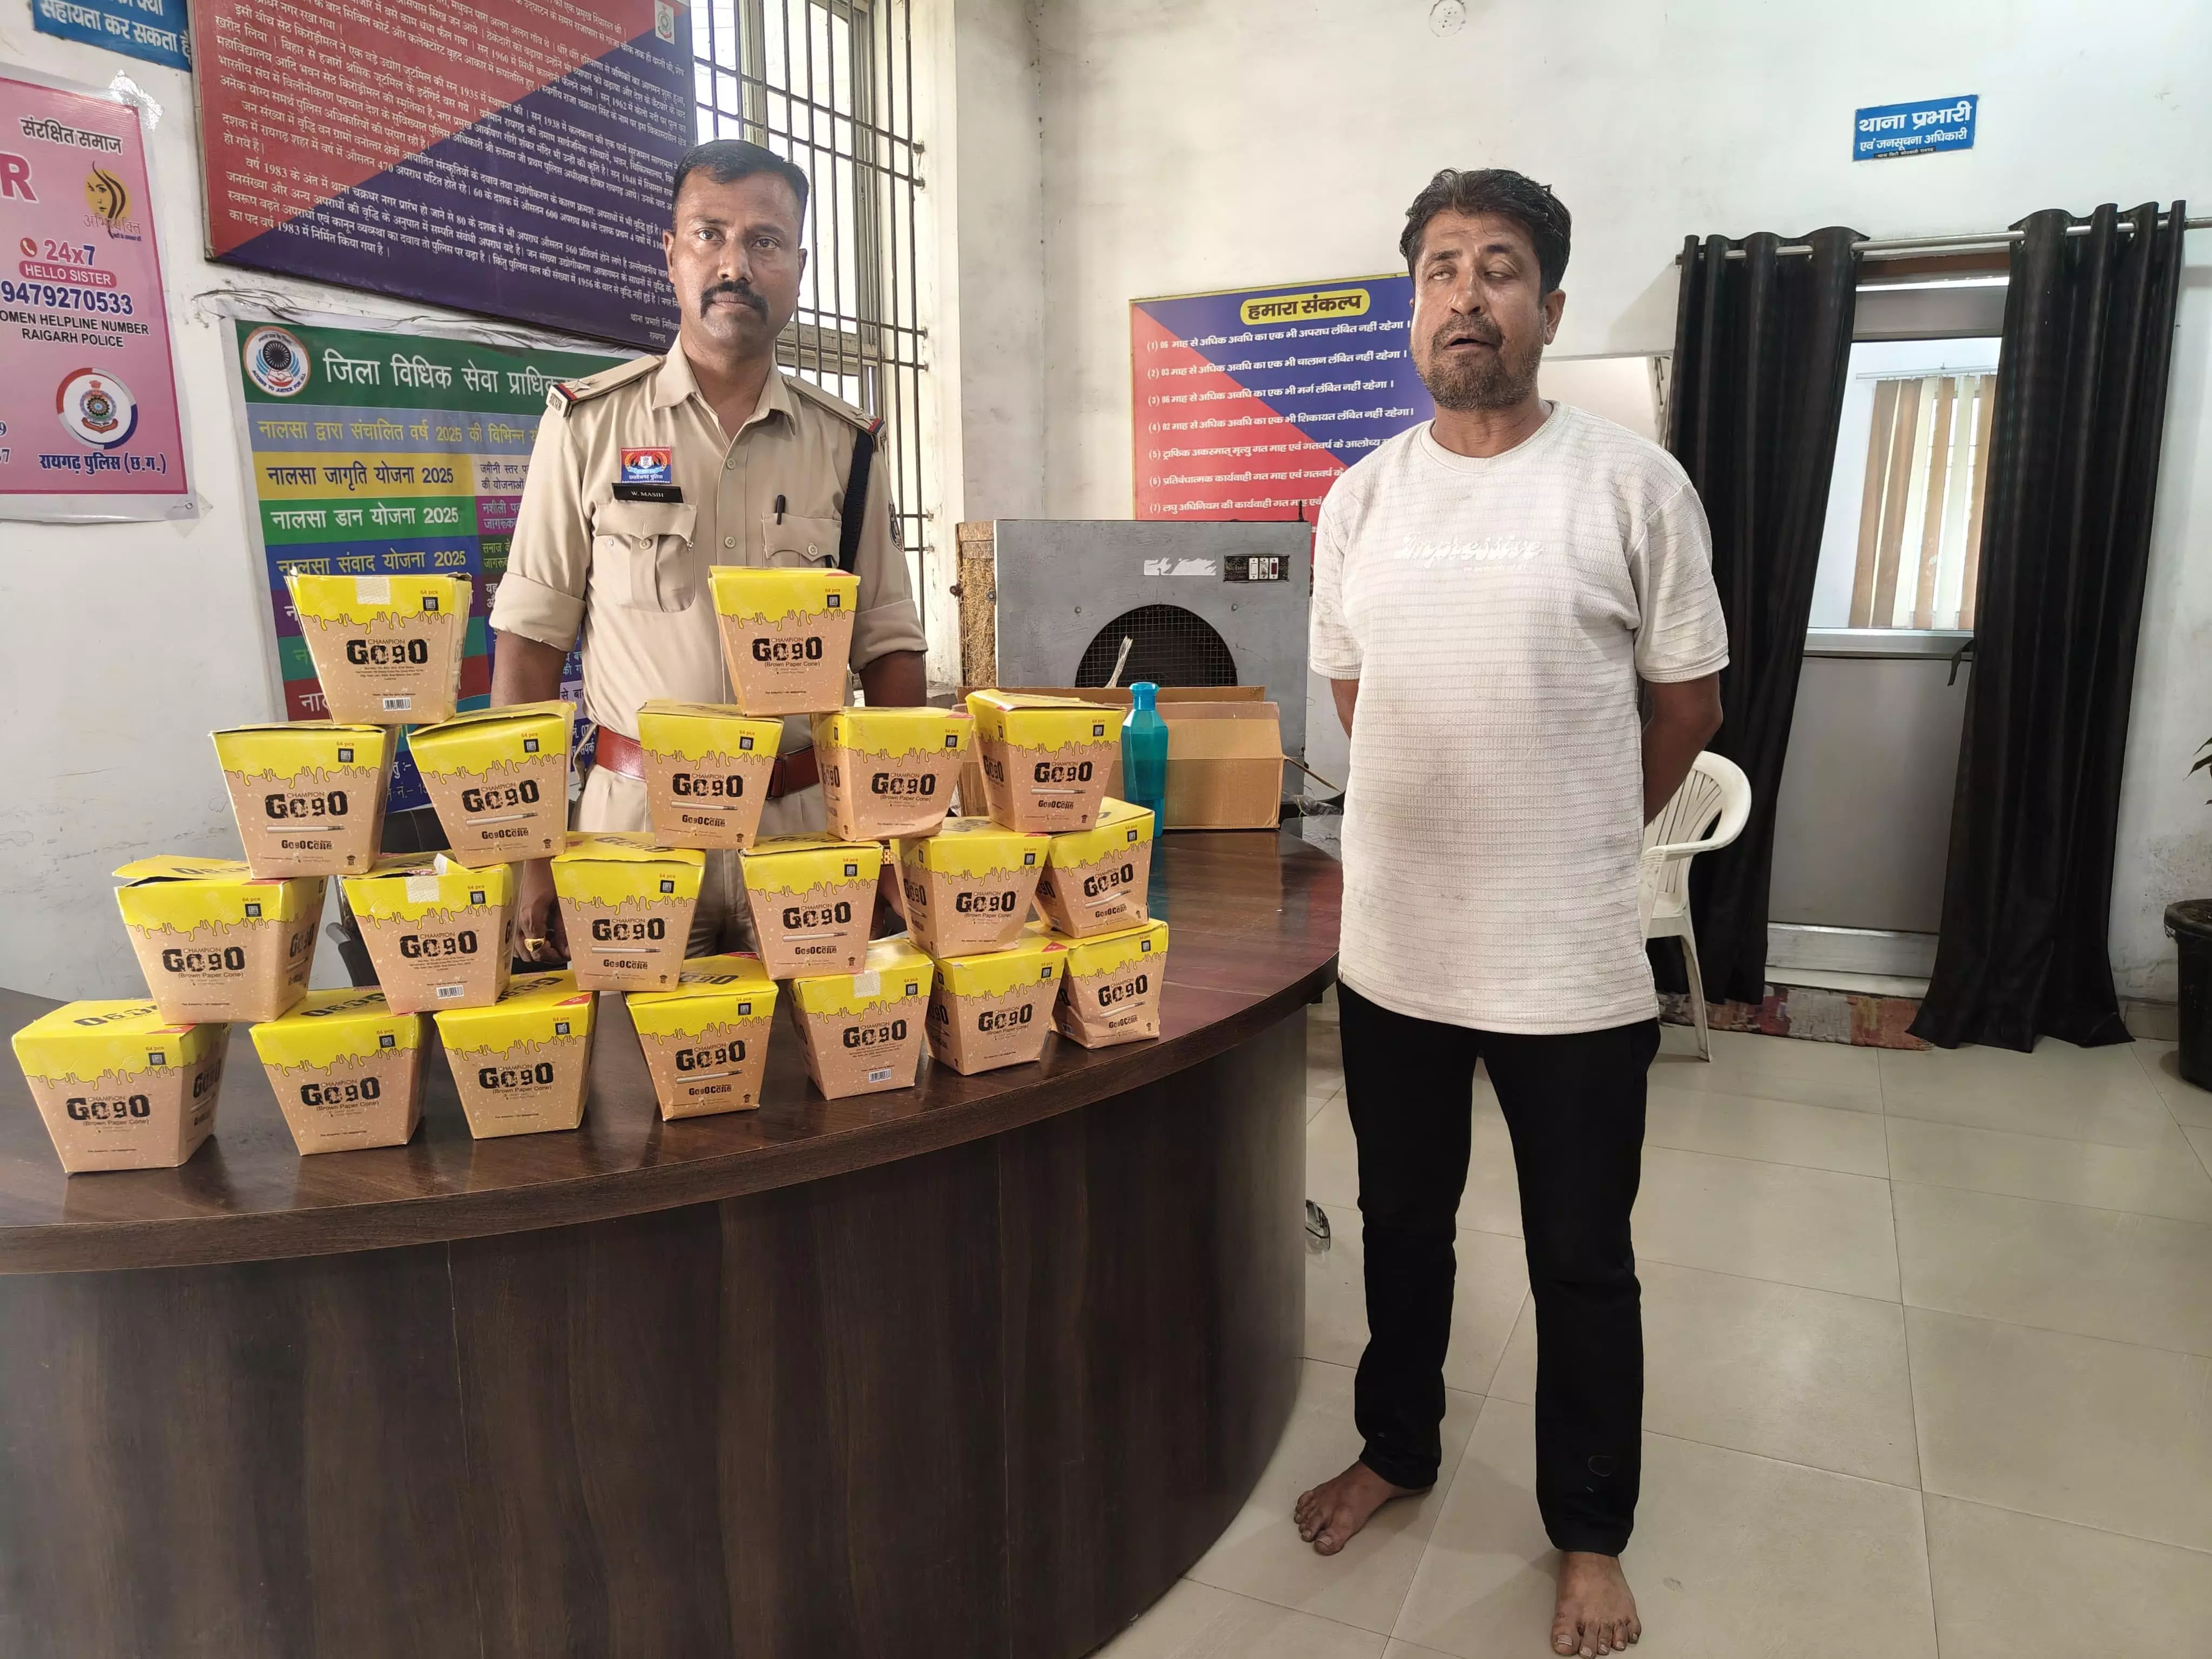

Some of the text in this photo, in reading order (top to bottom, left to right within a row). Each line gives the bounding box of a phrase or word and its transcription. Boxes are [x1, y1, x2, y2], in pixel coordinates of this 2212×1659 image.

[40, 1, 102, 30] सहायता
[104, 13, 130, 39] कर
[132, 21, 178, 52] सकता
[1859, 101, 1972, 132] थाना प्रभारी
[21, 117, 123, 154] संरक्षित समाज
[1860, 127, 1968, 151] एवं जनसूचना अधिकारी
[245, 156, 260, 170] वर्ष
[264, 163, 287, 178] 1983
[289, 166, 300, 180] के
[303, 172, 318, 186] अंत
[331, 181, 349, 194] थाना
[352, 187, 379, 203] चक्रधर
[381, 195, 396, 207] नगर
[399, 199, 417, 212] प्रारंभ
[420, 203, 427, 215] हो
[429, 207, 444, 219] जाने
[447, 209, 454, 222] से
[456, 215, 466, 225] 80
[468, 215, 476, 227] के
[477, 220, 496, 232] दशक
[228, 209, 242, 221] का
[244, 213, 258, 226] पद
[260, 215, 274, 228] वर्ष
[278, 221, 300, 234] 1983
[311, 225, 336, 243] निर्मित
[338, 232, 358, 248] किया
[360, 241, 375, 252] गया
[377, 241, 383, 255] है
[44, 239, 96, 266] 24x7
[24, 264, 111, 286] HELLO SISTER
[2, 281, 133, 315] 9479270533
[1248, 294, 1363, 320] हमारा संकल्प
[0, 310, 150, 335] OMEN HELPLINE NUMBER
[1190, 337, 1198, 346] से
[1199, 335, 1227, 346] अधिक
[1228, 332, 1253, 343] अवधि
[1268, 332, 1284, 340] एक
[1286, 328, 1297, 338] भी
[1298, 328, 1330, 337] अपराध
[1331, 323, 1357, 334] लंबित
[1358, 321, 1377, 332] नहीं
[1378, 320, 1404, 331] रहेगा
[22, 328, 124, 347] RAIGARH POLICE
[323, 348, 380, 385] जिला
[390, 353, 452, 389] विधिक
[461, 359, 498, 393] सेवा
[258, 420, 308, 440] नालसा
[314, 421, 343, 442] द्वारा
[350, 417, 404, 441] संचालित
[409, 418, 429, 442] वर्ष
[436, 426, 463, 442] 2025
[468, 423, 482, 443] की
[488, 423, 525, 444] विभिन्न
[1163, 448, 1190, 460] ट्राफिक
[1191, 447, 1232, 456] अकस्मात्
[1232, 446, 1251, 456] मृत्यु
[1288, 441, 1301, 451] एवं
[1302, 439, 1332, 449] गतवर्ष
[1333, 439, 1344, 448] के
[1345, 437, 1380, 448] आलोच्य
[38, 452, 167, 475] रायगढ़ पुलिस (छ.ग.)
[266, 461, 454, 491] नालसा जागृति योजना 2025
[480, 462, 518, 475] जमीनी स्तर
[481, 478, 524, 490] की योजनाओं
[272, 503, 459, 529] नालसा डान योजना 2025
[482, 500, 507, 515] नशीली
[276, 548, 466, 576] नालसा संवाद योजना 2025
[481, 782, 517, 792] CHAMPION
[420, 931, 455, 940] CHAMPION
[860, 1021, 890, 1030] CHAMPION
[498, 1064, 533, 1072] CHAMPION
[321, 1077, 357, 1087] CHAMPION
